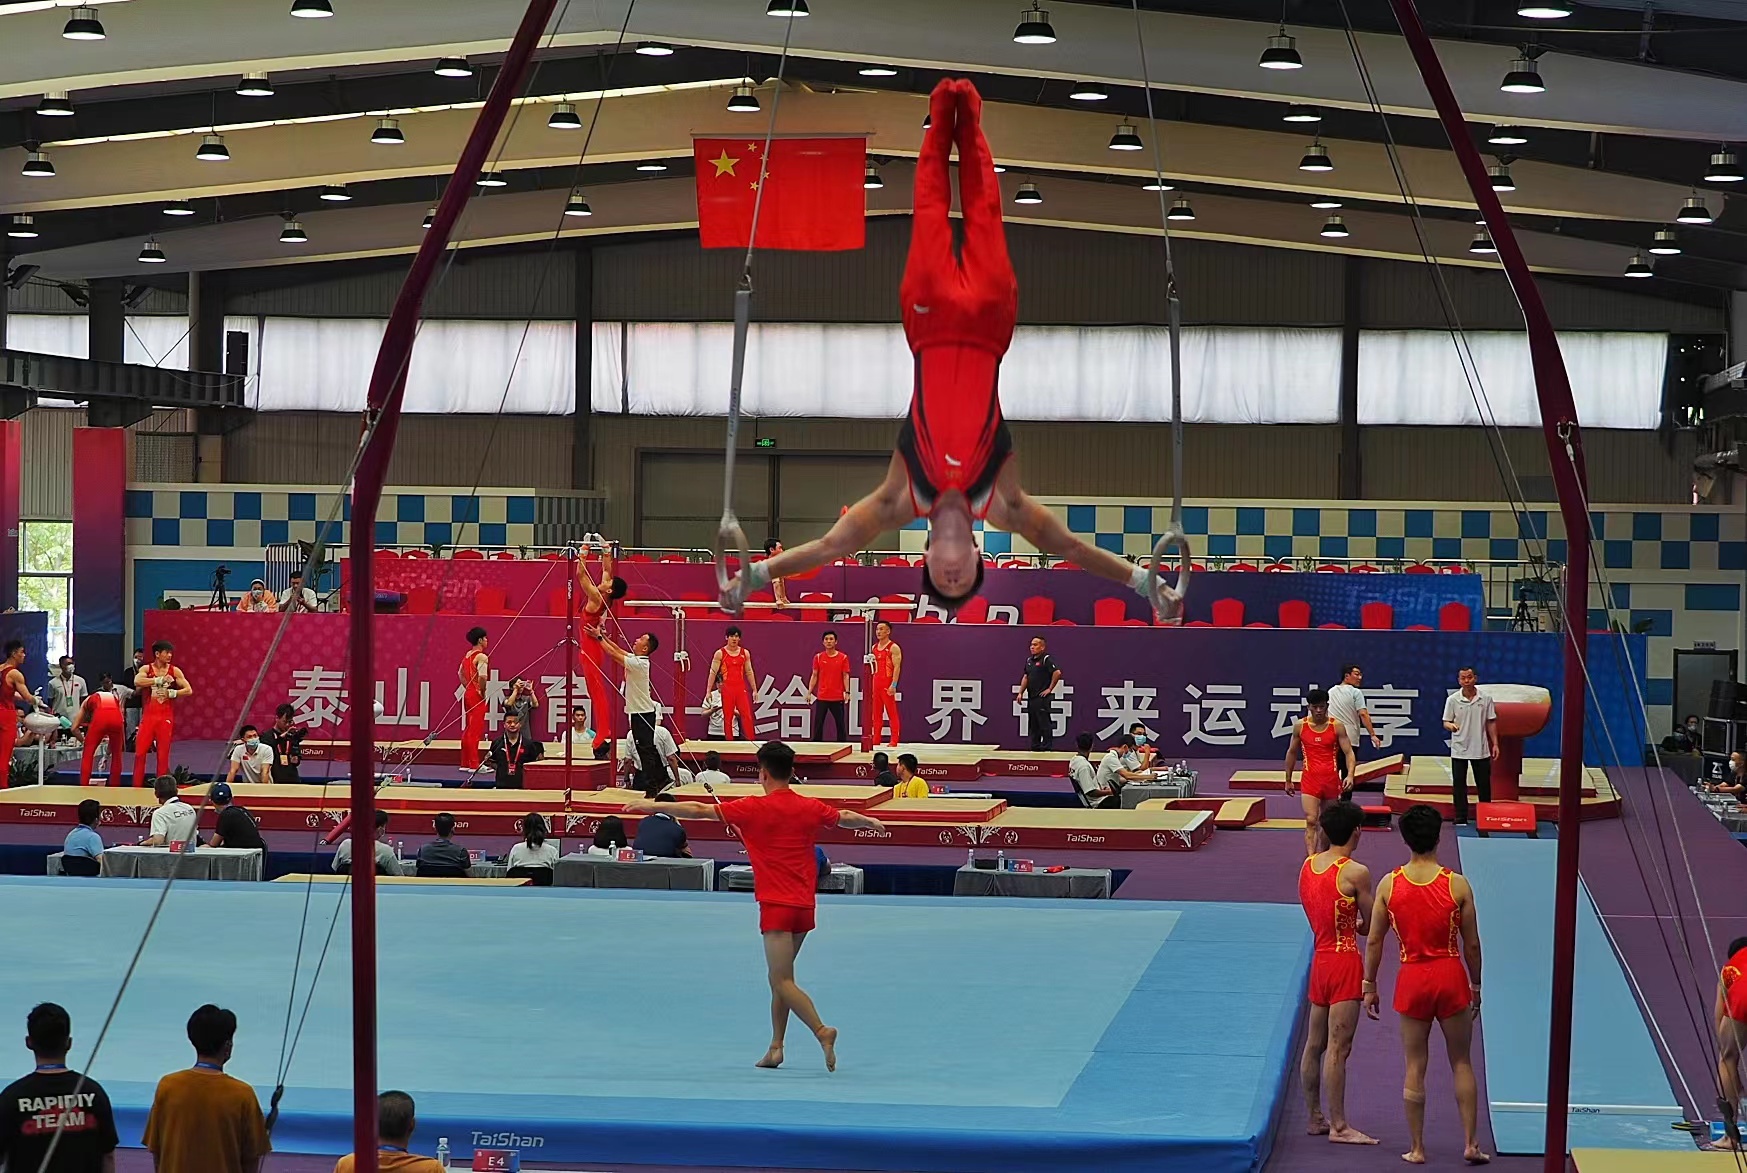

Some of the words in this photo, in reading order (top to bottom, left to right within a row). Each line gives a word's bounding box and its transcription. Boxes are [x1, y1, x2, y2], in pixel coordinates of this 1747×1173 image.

[917, 767, 948, 775] TaiShan
[1008, 763, 1039, 771] TaiShan
[20, 808, 57, 817] TaiShan
[1066, 833, 1106, 843] TaiShan
[18, 1092, 96, 1112] RAPIDIY
[32, 1111, 85, 1129] TEAM
[471, 1131, 545, 1148] TaiShan
[488, 1156, 505, 1167] E4
